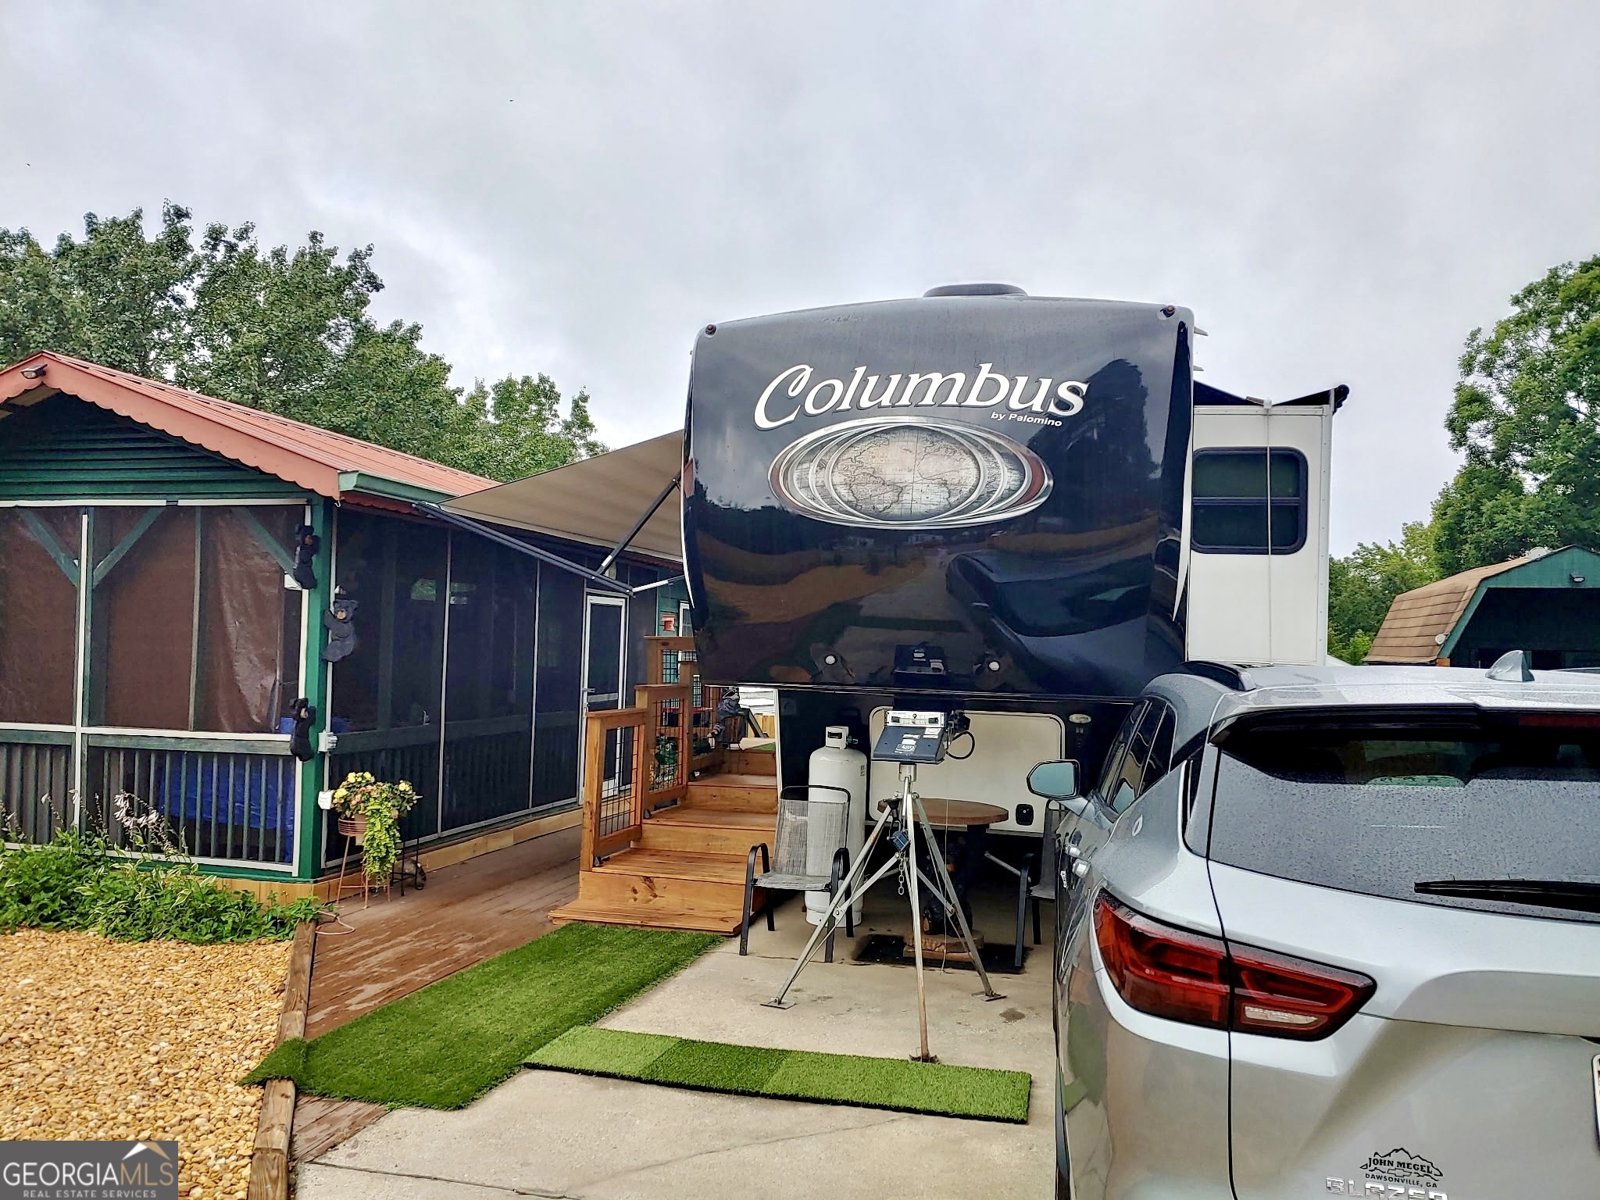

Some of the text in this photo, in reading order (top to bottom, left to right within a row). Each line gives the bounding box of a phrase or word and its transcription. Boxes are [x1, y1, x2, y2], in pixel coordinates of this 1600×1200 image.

[754, 363, 1089, 430] Columbus
[991, 411, 1063, 427] by Palomino
[1368, 1157, 1433, 1175] JOHN MEGEL
[1365, 1173, 1423, 1188] DAWSONVILLE,
